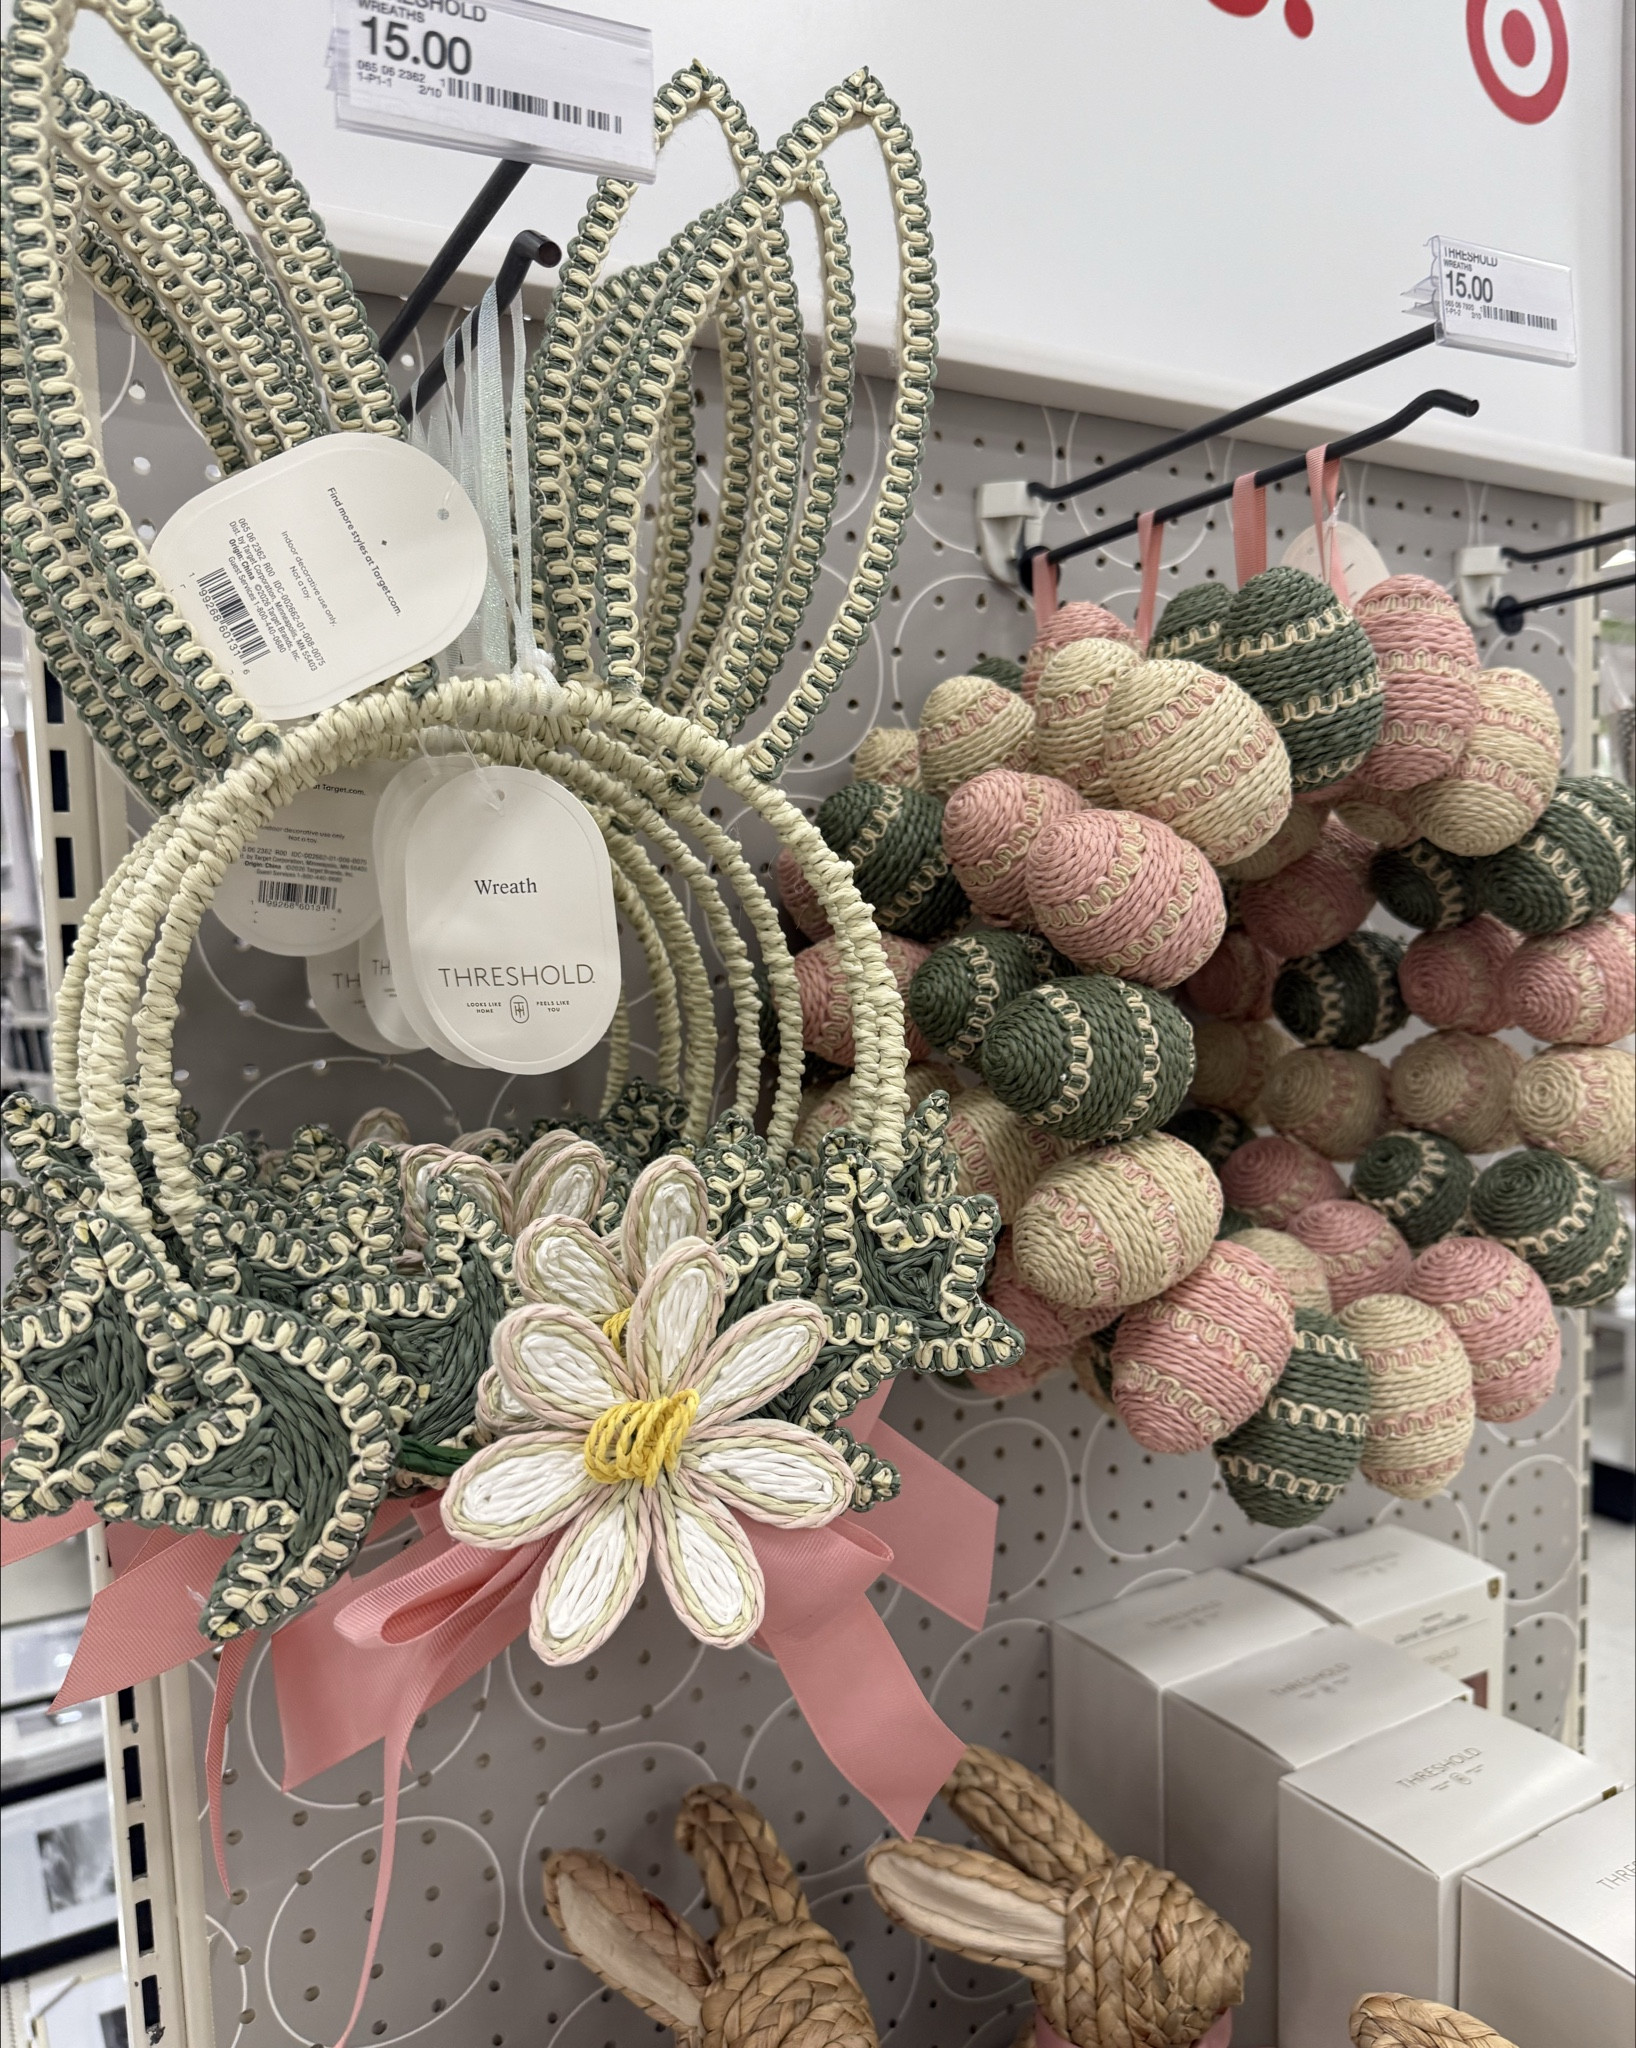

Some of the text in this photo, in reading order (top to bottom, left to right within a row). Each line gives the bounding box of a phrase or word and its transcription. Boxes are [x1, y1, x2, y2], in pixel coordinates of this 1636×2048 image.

[358, 0, 425, 23] WREATHS
[361, 16, 472, 76] 15.00
[419, 85, 443, 98] 2/10
[1444, 259, 1473, 272] WREATHS
[1446, 270, 1493, 303] 15.00
[238, 518, 250, 532] 065
[246, 532, 256, 542] 06
[252, 542, 266, 561] 2362
[263, 562, 275, 577] R00
[328, 487, 401, 616] Find more styles at Target.com.
[229, 556, 242, 575] Guest
[239, 575, 256, 601] Services
[229, 521, 317, 671] Dist. by Target Corporation, Minneapolis, MN 55403
[281, 531, 336, 626] Indoor decorative use only.
[290, 566, 311, 600] Not a toy.
[229, 539, 244, 561] Origin:
[241, 561, 255, 580] China
[265, 606, 281, 627] Target
[278, 626, 293, 651] Brands,
[291, 650, 300, 662] Inc.
[199, 589, 222, 623] 99268
[219, 625, 241, 657] 60131
[474, 877, 538, 895] Wreath
[438, 964, 595, 988] THRESHOLD
[1395, 1747, 1482, 1788] THRESHOLD
